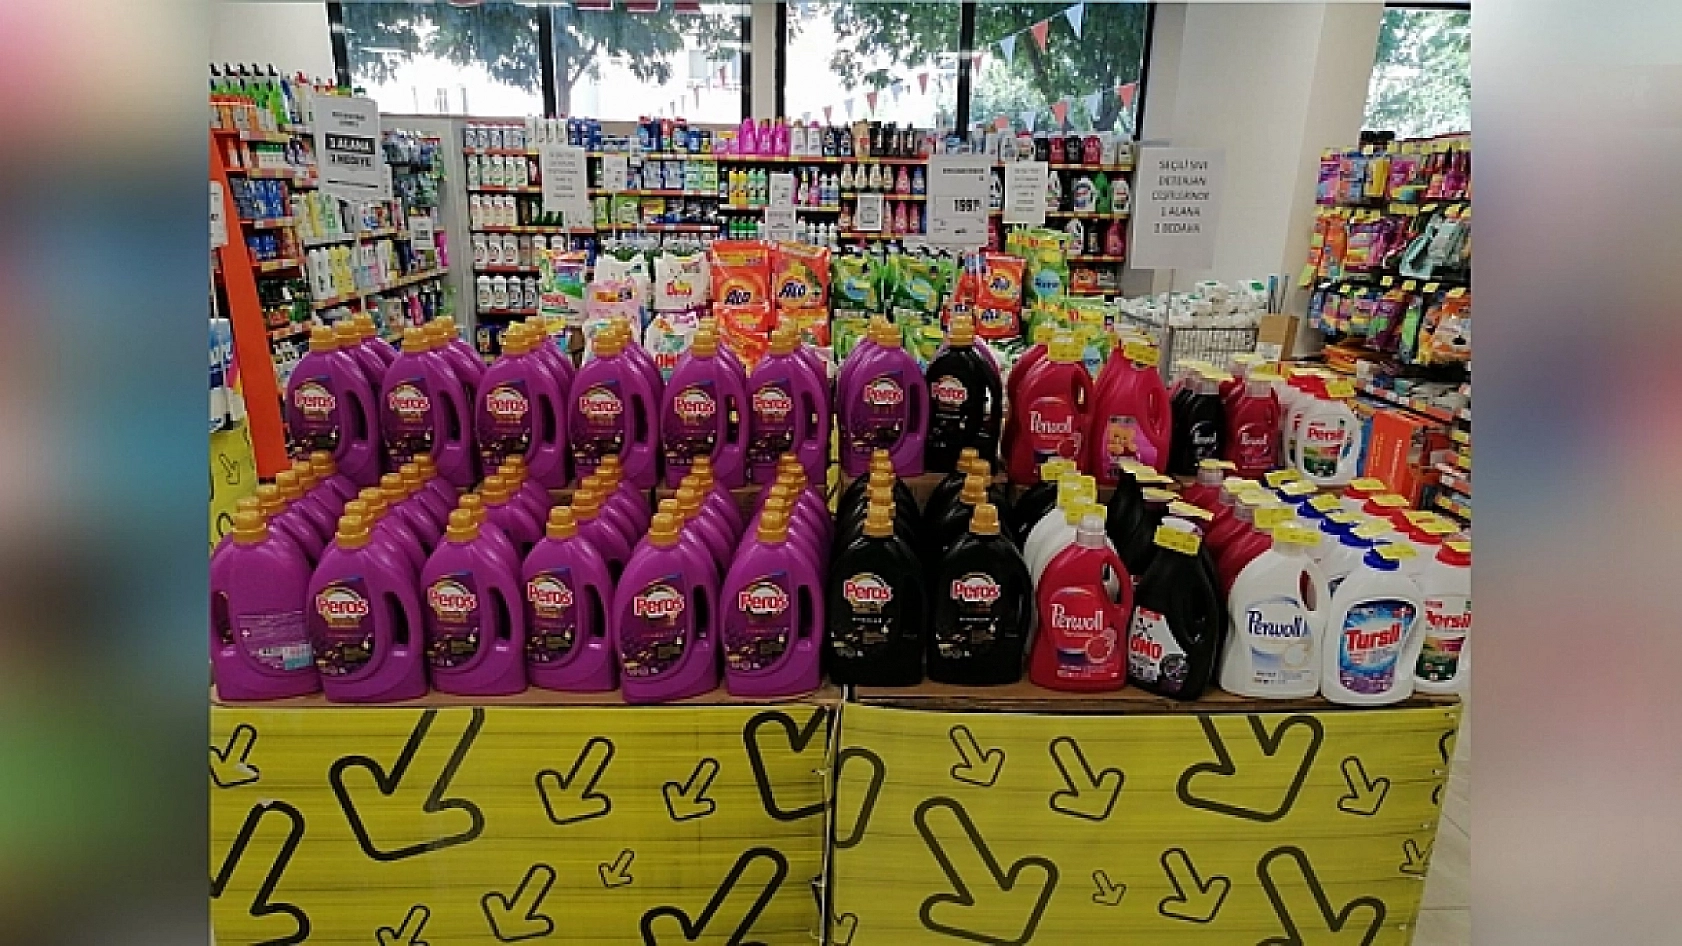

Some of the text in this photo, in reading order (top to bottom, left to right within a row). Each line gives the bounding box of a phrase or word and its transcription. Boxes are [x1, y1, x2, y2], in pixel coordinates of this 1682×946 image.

[427, 585, 478, 610] Peros
[527, 581, 573, 605] Peros
[739, 590, 789, 613] Peros
[843, 579, 893, 601] Peros
[953, 579, 1001, 601] Peros
[316, 593, 369, 615] Peros
[634, 594, 685, 616] Peros
[1051, 604, 1104, 631] Perwoll
[1247, 610, 1303, 637] Perwoll
[1345, 622, 1400, 651] Tursil
